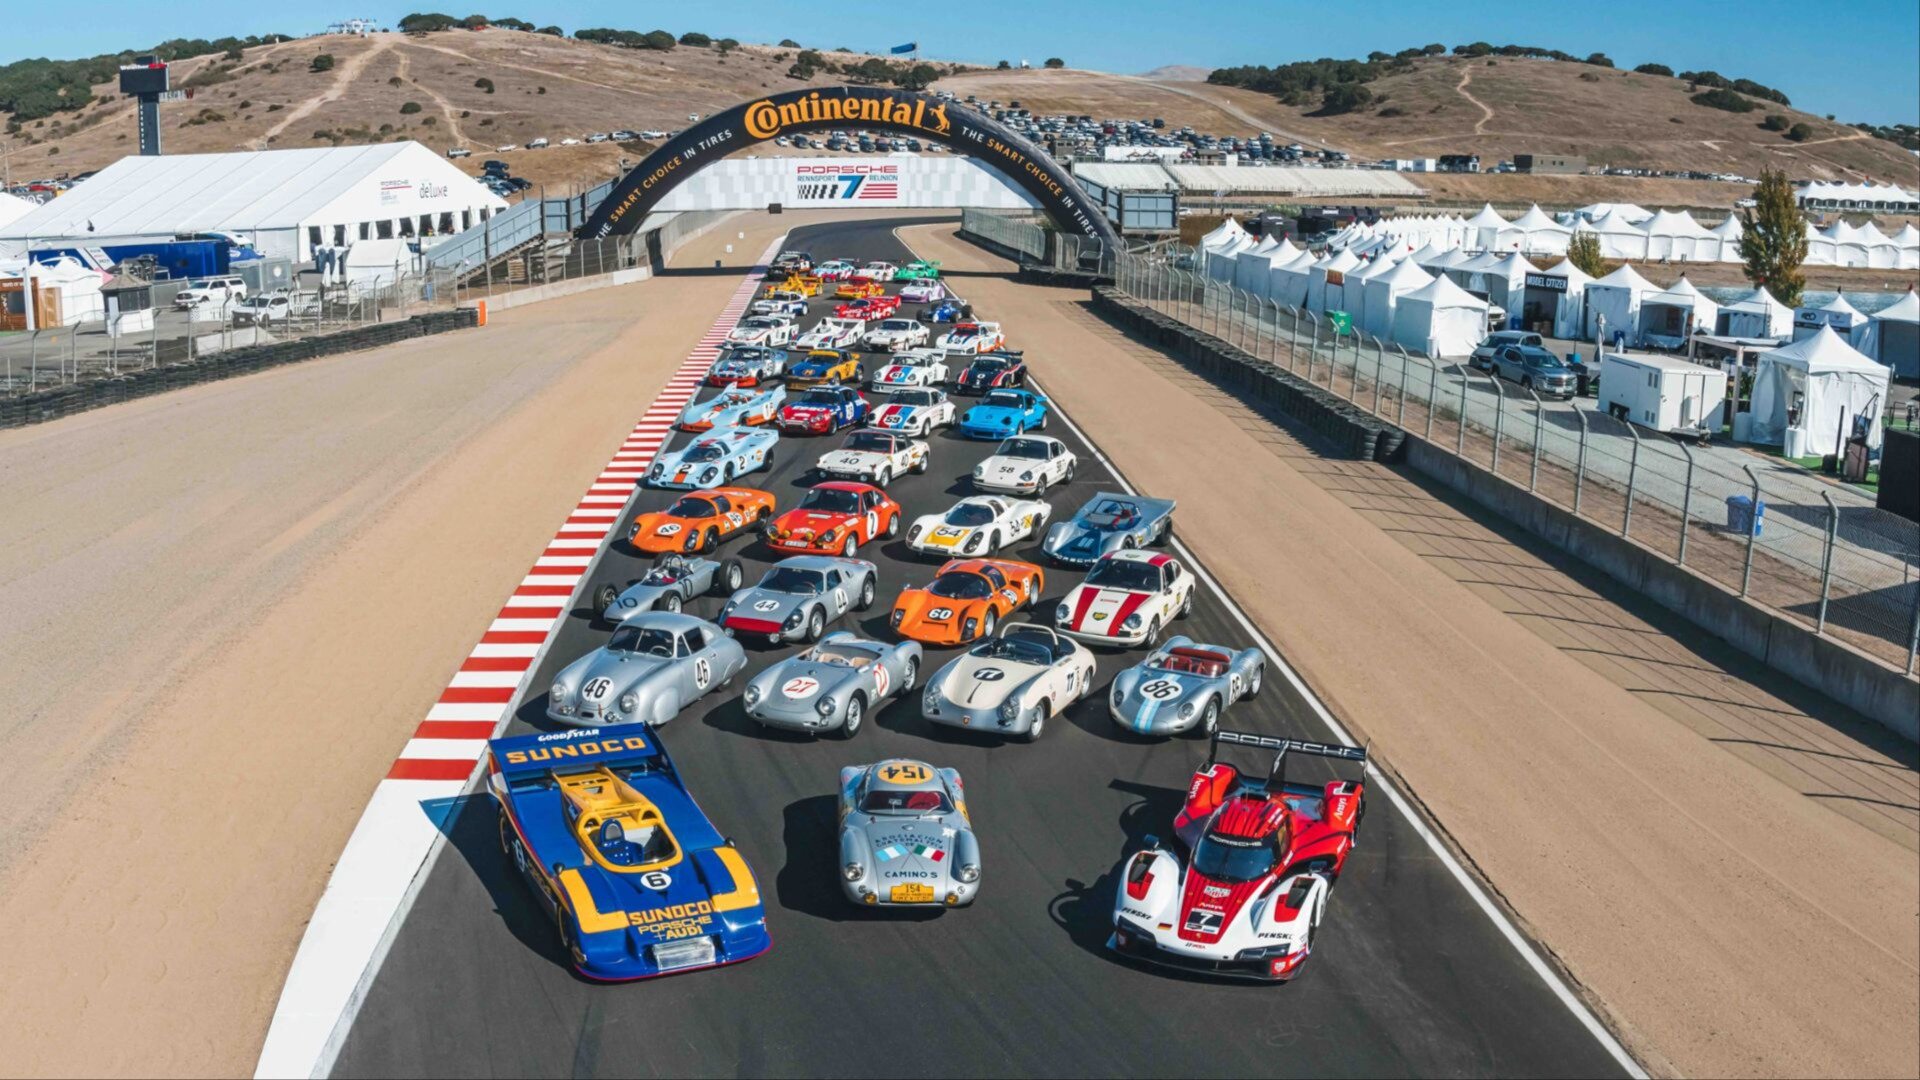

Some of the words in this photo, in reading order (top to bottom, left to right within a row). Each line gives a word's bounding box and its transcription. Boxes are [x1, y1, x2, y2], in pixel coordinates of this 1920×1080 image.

[744, 92, 926, 139] Continental
[797, 166, 898, 174] PORSCHE
[594, 222, 612, 245] THE
[610, 188, 642, 222] SMART
[643, 156, 682, 189] CHOICE
[683, 147, 697, 160] IN
[697, 129, 733, 151] TIRES
[838, 175, 866, 199] 7
[961, 126, 985, 143] THE
[986, 138, 1025, 165] SMART
[1025, 162, 1063, 197] CHOICE
[1061, 196, 1075, 209] IN
[1073, 209, 1099, 239] TIRES
[419, 182, 448, 199] deluxe
[1526, 275, 1545, 287] MODEL
[1545, 278, 1567, 290] CITIZEN
[738, 455, 746, 471] 2
[839, 457, 860, 465] 40
[678, 463, 693, 475] 2
[660, 524, 680, 533] 46
[936, 528, 962, 537] 54
[616, 597, 638, 609] 10
[756, 601, 777, 610] 44
[928, 608, 953, 619] 60
[696, 659, 709, 685] 46
[975, 669, 1003, 679] 77
[583, 677, 611, 699] 46
[784, 678, 817, 694] 27
[1142, 680, 1180, 699] 86
[537, 728, 600, 742] GOODYEAR
[506, 736, 647, 764] SUNOCO
[1218, 731, 1364, 758] PORSCHE
[884, 765, 926, 780] 154
[1208, 833, 1263, 848] PORSCHE
[645, 873, 667, 888] 6
[904, 884, 921, 894] 154
[628, 900, 712, 926] SUNOCO
[1200, 912, 1214, 925] 7
[638, 914, 713, 935] PORSCHE
